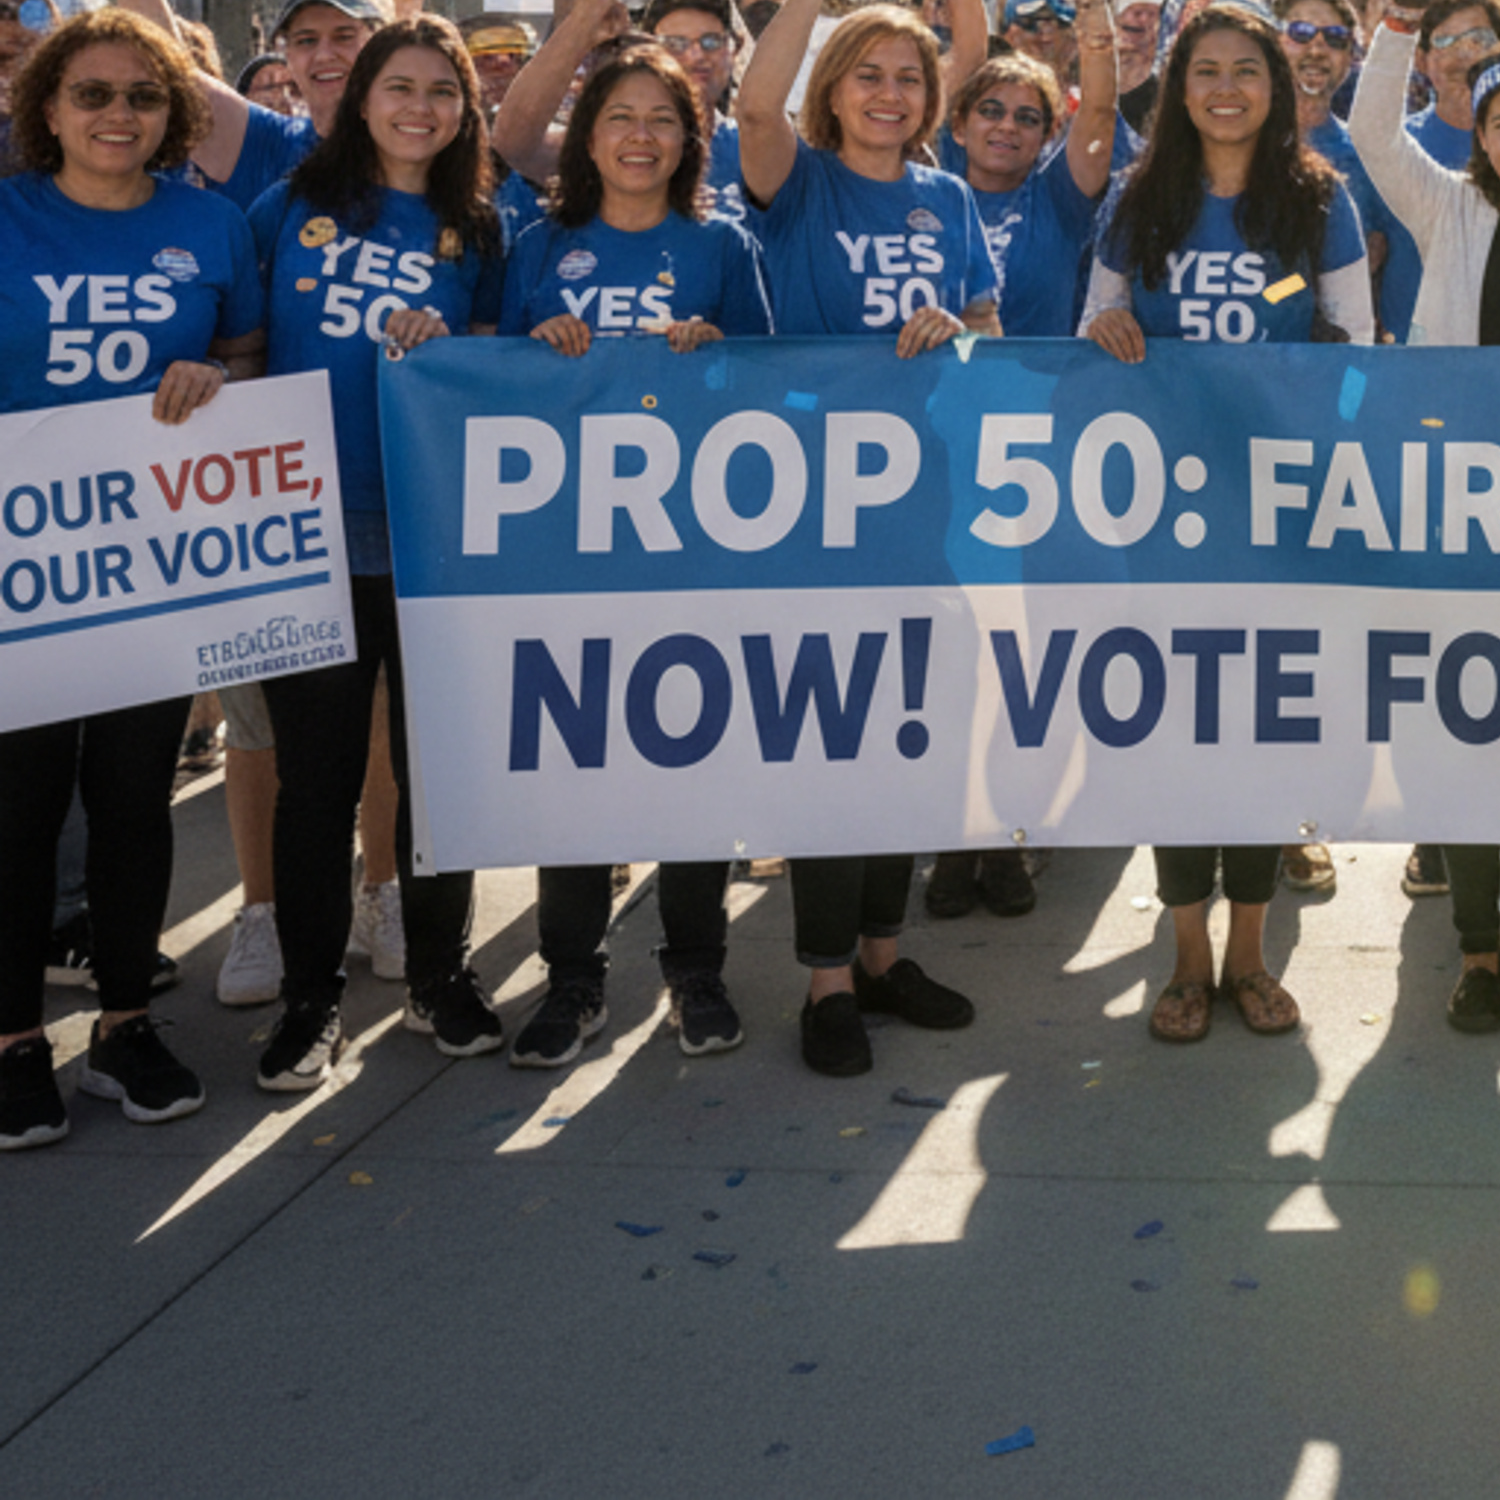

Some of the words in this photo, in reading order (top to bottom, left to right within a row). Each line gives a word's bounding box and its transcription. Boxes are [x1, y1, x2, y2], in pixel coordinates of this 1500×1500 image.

[318, 236, 436, 295] YES
[834, 230, 945, 276] YES
[1165, 250, 1267, 297] YES
[32, 273, 178, 324] YES
[559, 285, 675, 333] YES
[861, 277, 938, 328] 50
[1178, 300, 1256, 344] 50
[45, 329, 151, 387] 50
[2, 470, 139, 538] OUR
[149, 439, 324, 513] VOTE,
[461, 409, 922, 557] PROP
[968, 410, 1208, 548] 50:
[1, 544, 136, 614] OUR
[147, 507, 329, 587] VOICE
[507, 617, 932, 772] NOW!
[990, 625, 1322, 750] VOTE
